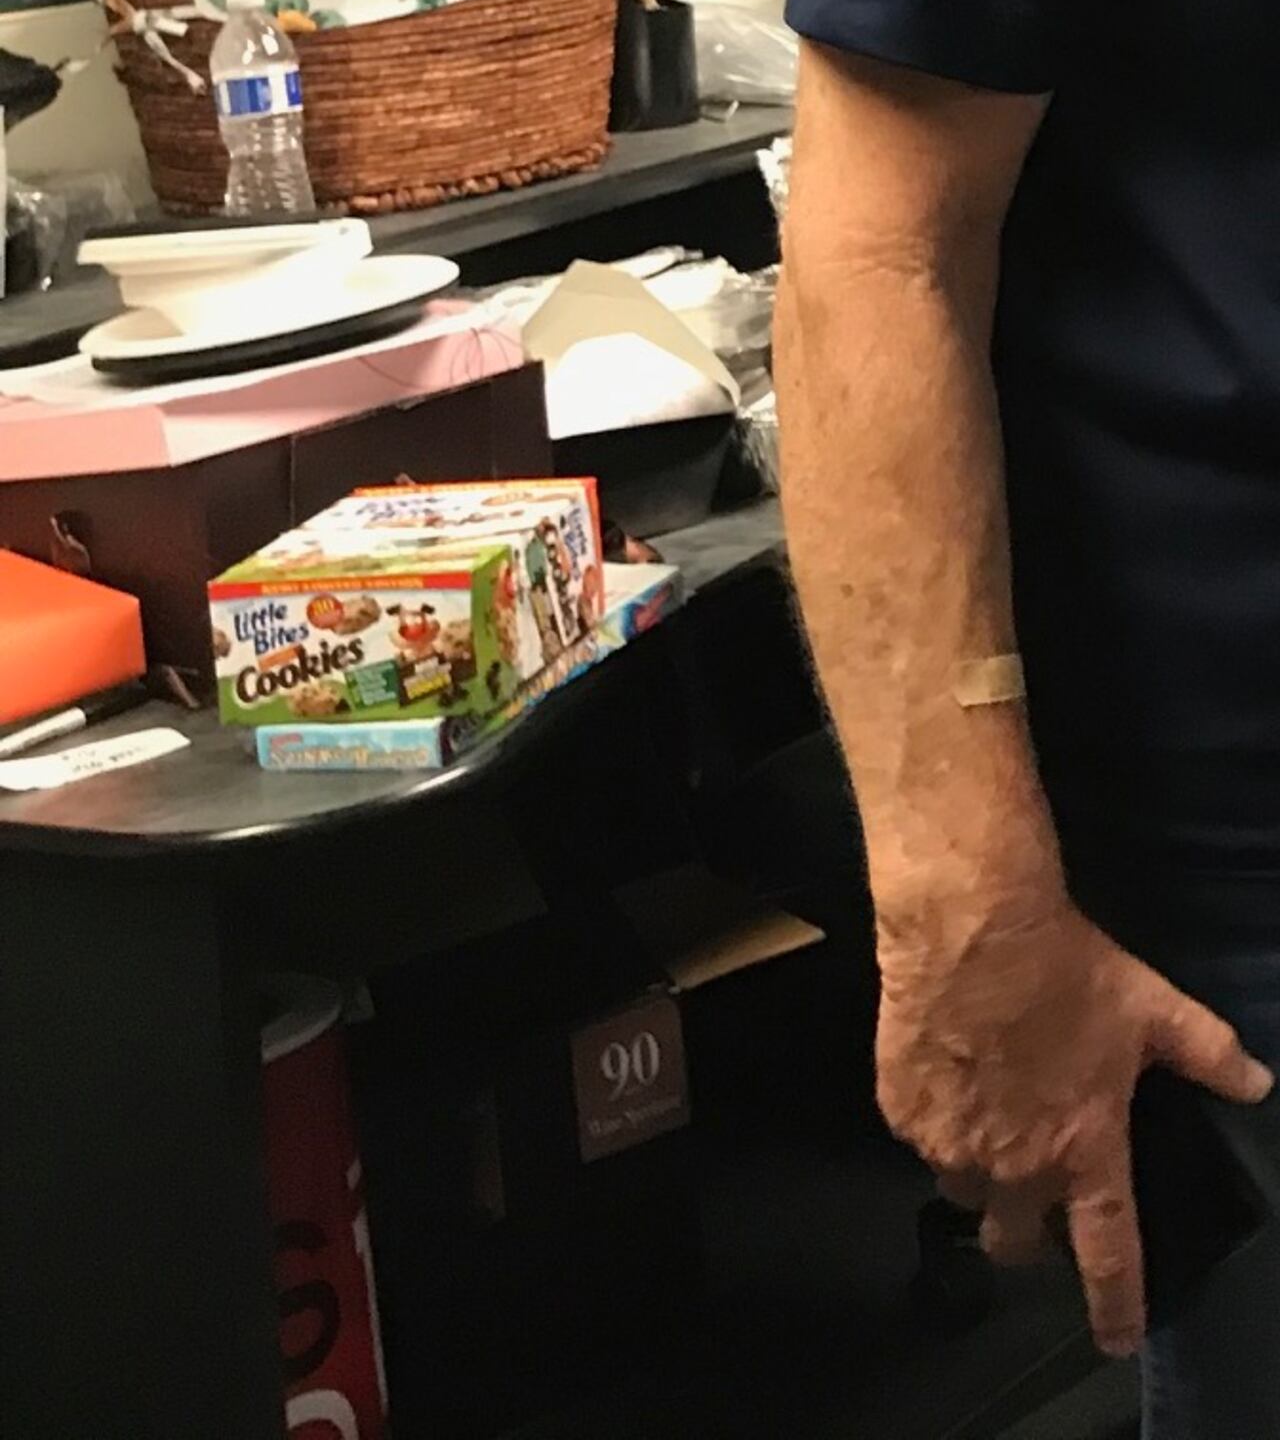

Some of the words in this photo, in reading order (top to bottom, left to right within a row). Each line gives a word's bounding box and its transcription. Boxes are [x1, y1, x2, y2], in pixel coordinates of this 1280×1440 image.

[234, 602, 287, 642] Little
[254, 623, 310, 656] Bites
[236, 637, 365, 704] Cookies
[602, 1031, 660, 1101] 90
